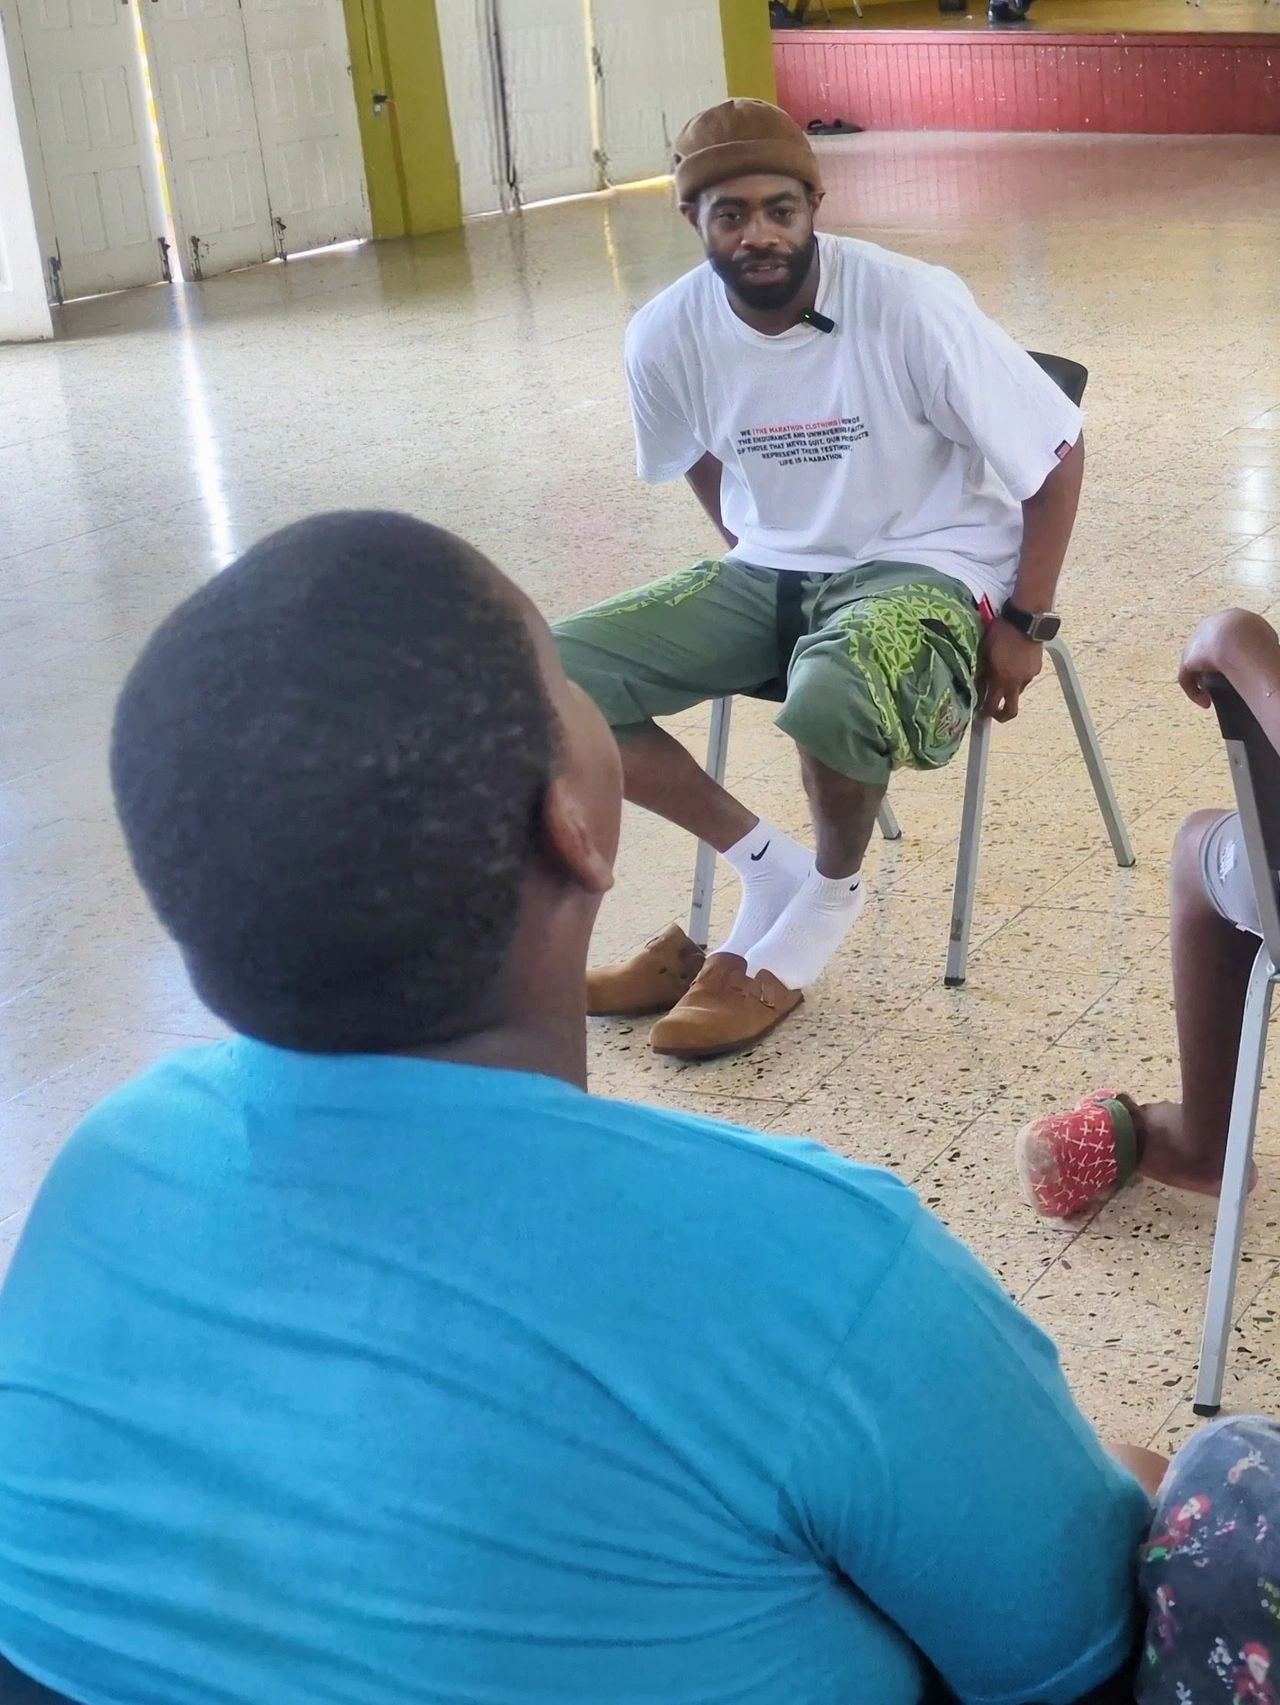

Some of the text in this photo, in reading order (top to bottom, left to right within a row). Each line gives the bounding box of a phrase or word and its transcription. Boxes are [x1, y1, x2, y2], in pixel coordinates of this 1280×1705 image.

[769, 424, 804, 433] MARATHON
[752, 433, 792, 444] ENDURANCE
[747, 444, 769, 454] THOSE
[769, 442, 785, 450] THAT
[786, 440, 807, 448] NEVER
[826, 436, 841, 444] OUR
[761, 448, 800, 459] REPRESENT
[801, 447, 819, 455] THEIR
[779, 458, 793, 466] LIFE
